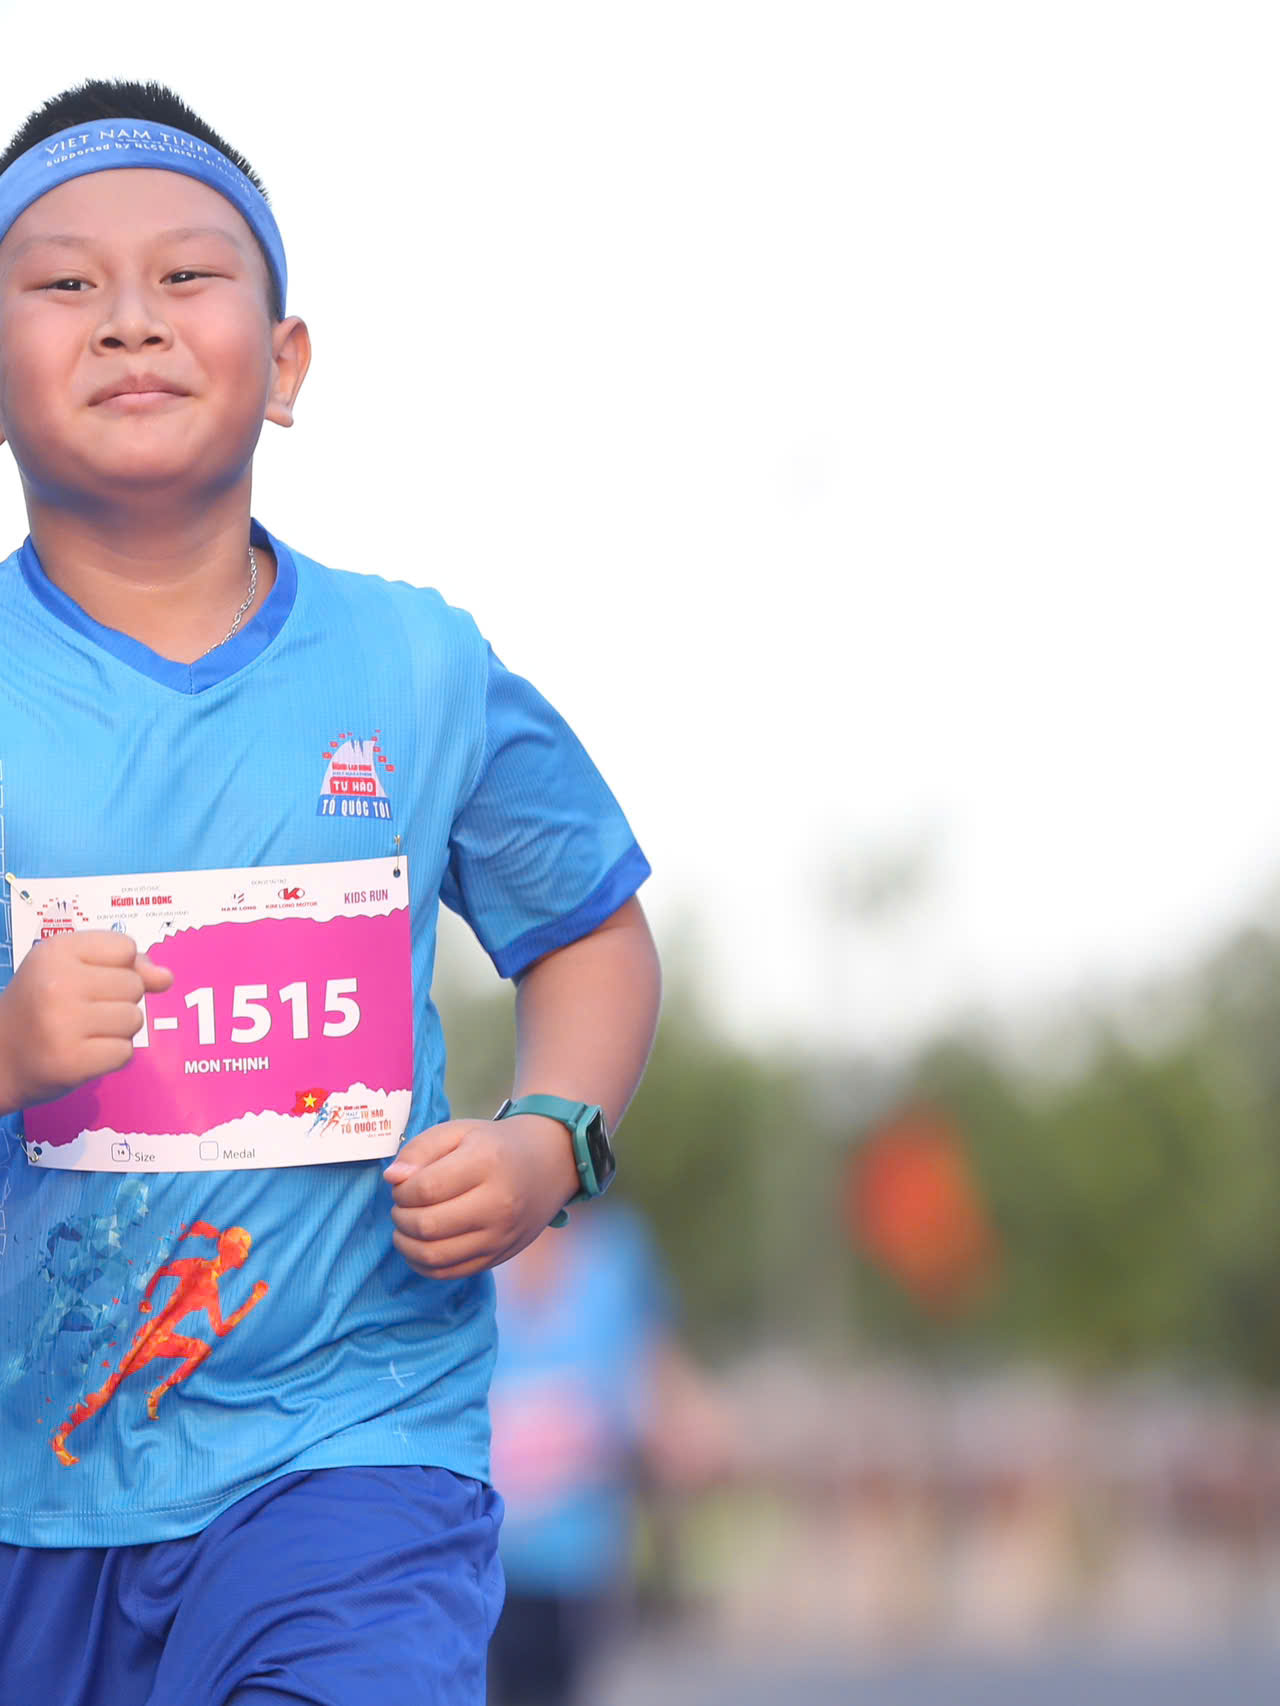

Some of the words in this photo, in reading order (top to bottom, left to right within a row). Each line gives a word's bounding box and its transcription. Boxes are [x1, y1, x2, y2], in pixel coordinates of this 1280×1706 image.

[100, 129, 151, 140] NAM
[344, 891, 367, 904] KIDS
[369, 889, 388, 902] RUN
[184, 1059, 220, 1074] MON
[222, 1056, 269, 1075] THỊNH
[134, 1151, 155, 1163] Size
[223, 1148, 256, 1160] Medal
